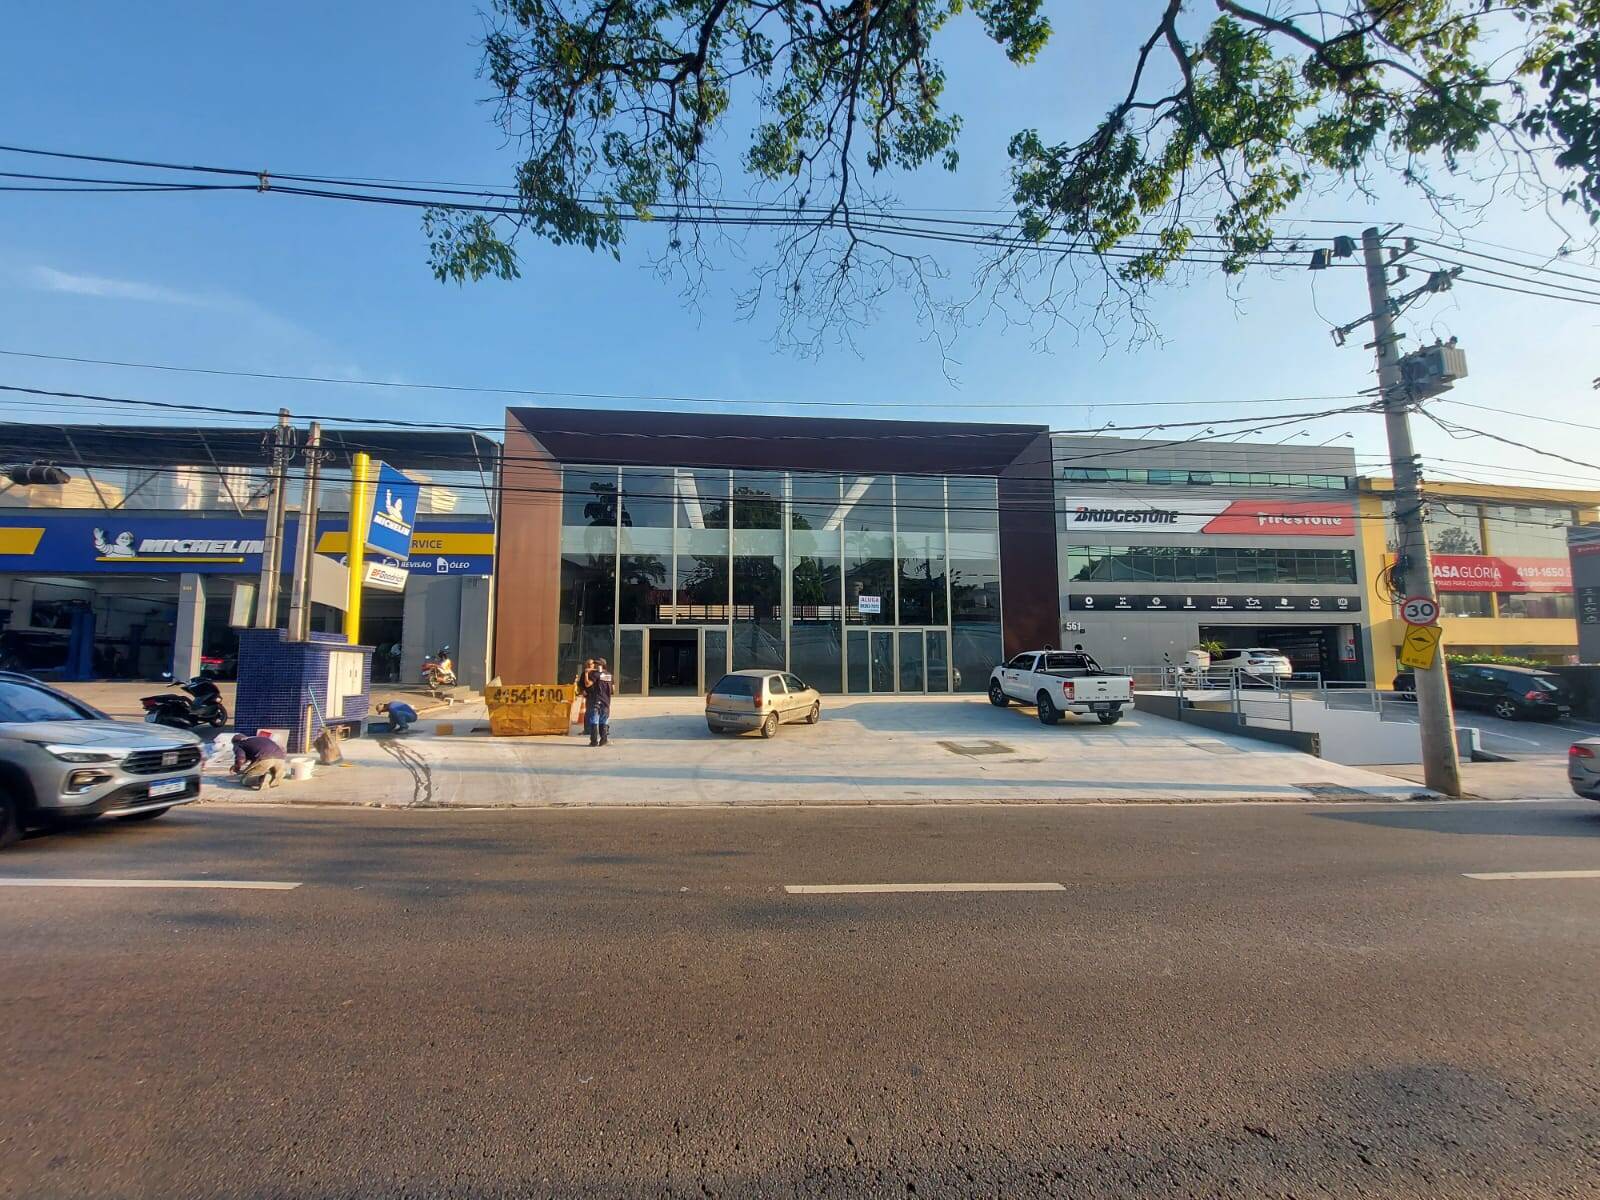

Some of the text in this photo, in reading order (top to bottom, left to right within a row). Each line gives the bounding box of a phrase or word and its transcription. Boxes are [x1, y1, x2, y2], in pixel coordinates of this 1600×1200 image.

[1074, 507, 1178, 523] BRIDGESTONE
[374, 514, 410, 536] MICHELIN
[138, 539, 264, 553] MICHELIN
[411, 540, 443, 549] RVICE
[1433, 564, 1501, 579] ASA GLÓRIA
[1407, 603, 1433, 617] 30
[1066, 622, 1081, 631] 561
